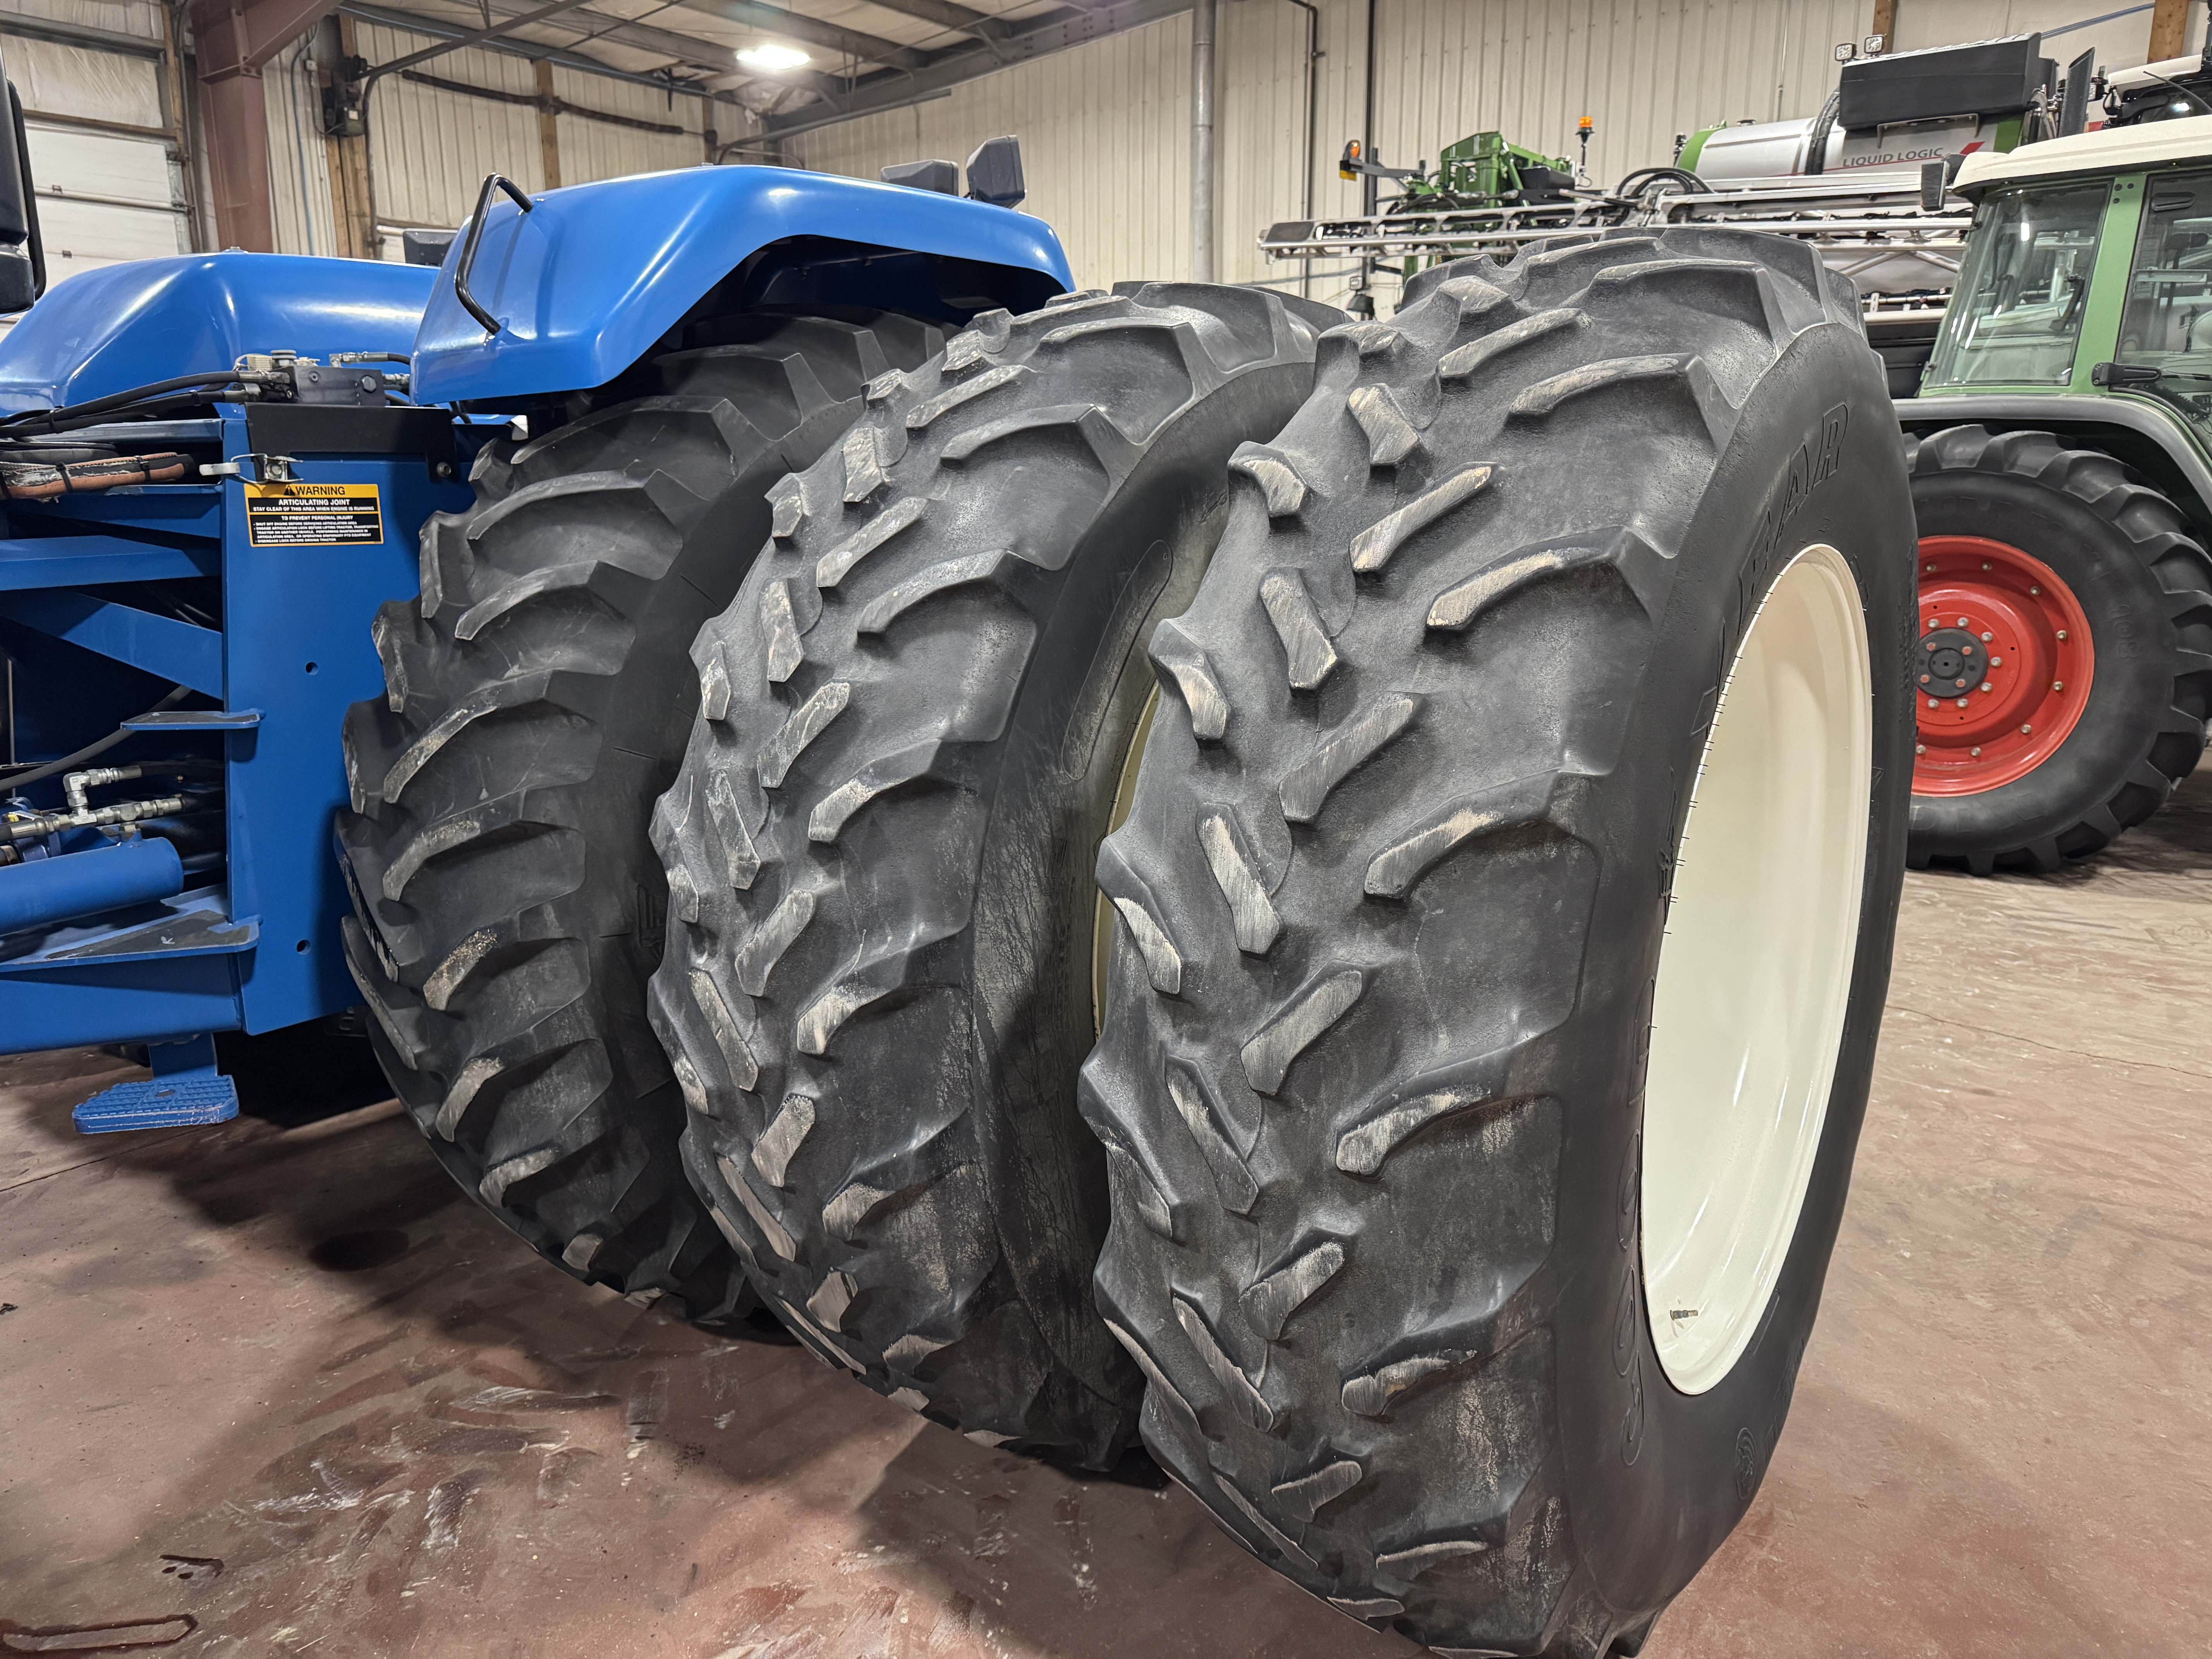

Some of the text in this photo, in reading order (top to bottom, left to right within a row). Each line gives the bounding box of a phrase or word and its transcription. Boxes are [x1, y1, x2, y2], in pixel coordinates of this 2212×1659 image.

[1843, 148, 1944, 167] LIQUID LOGIC
[295, 486, 345, 495] WARNING
